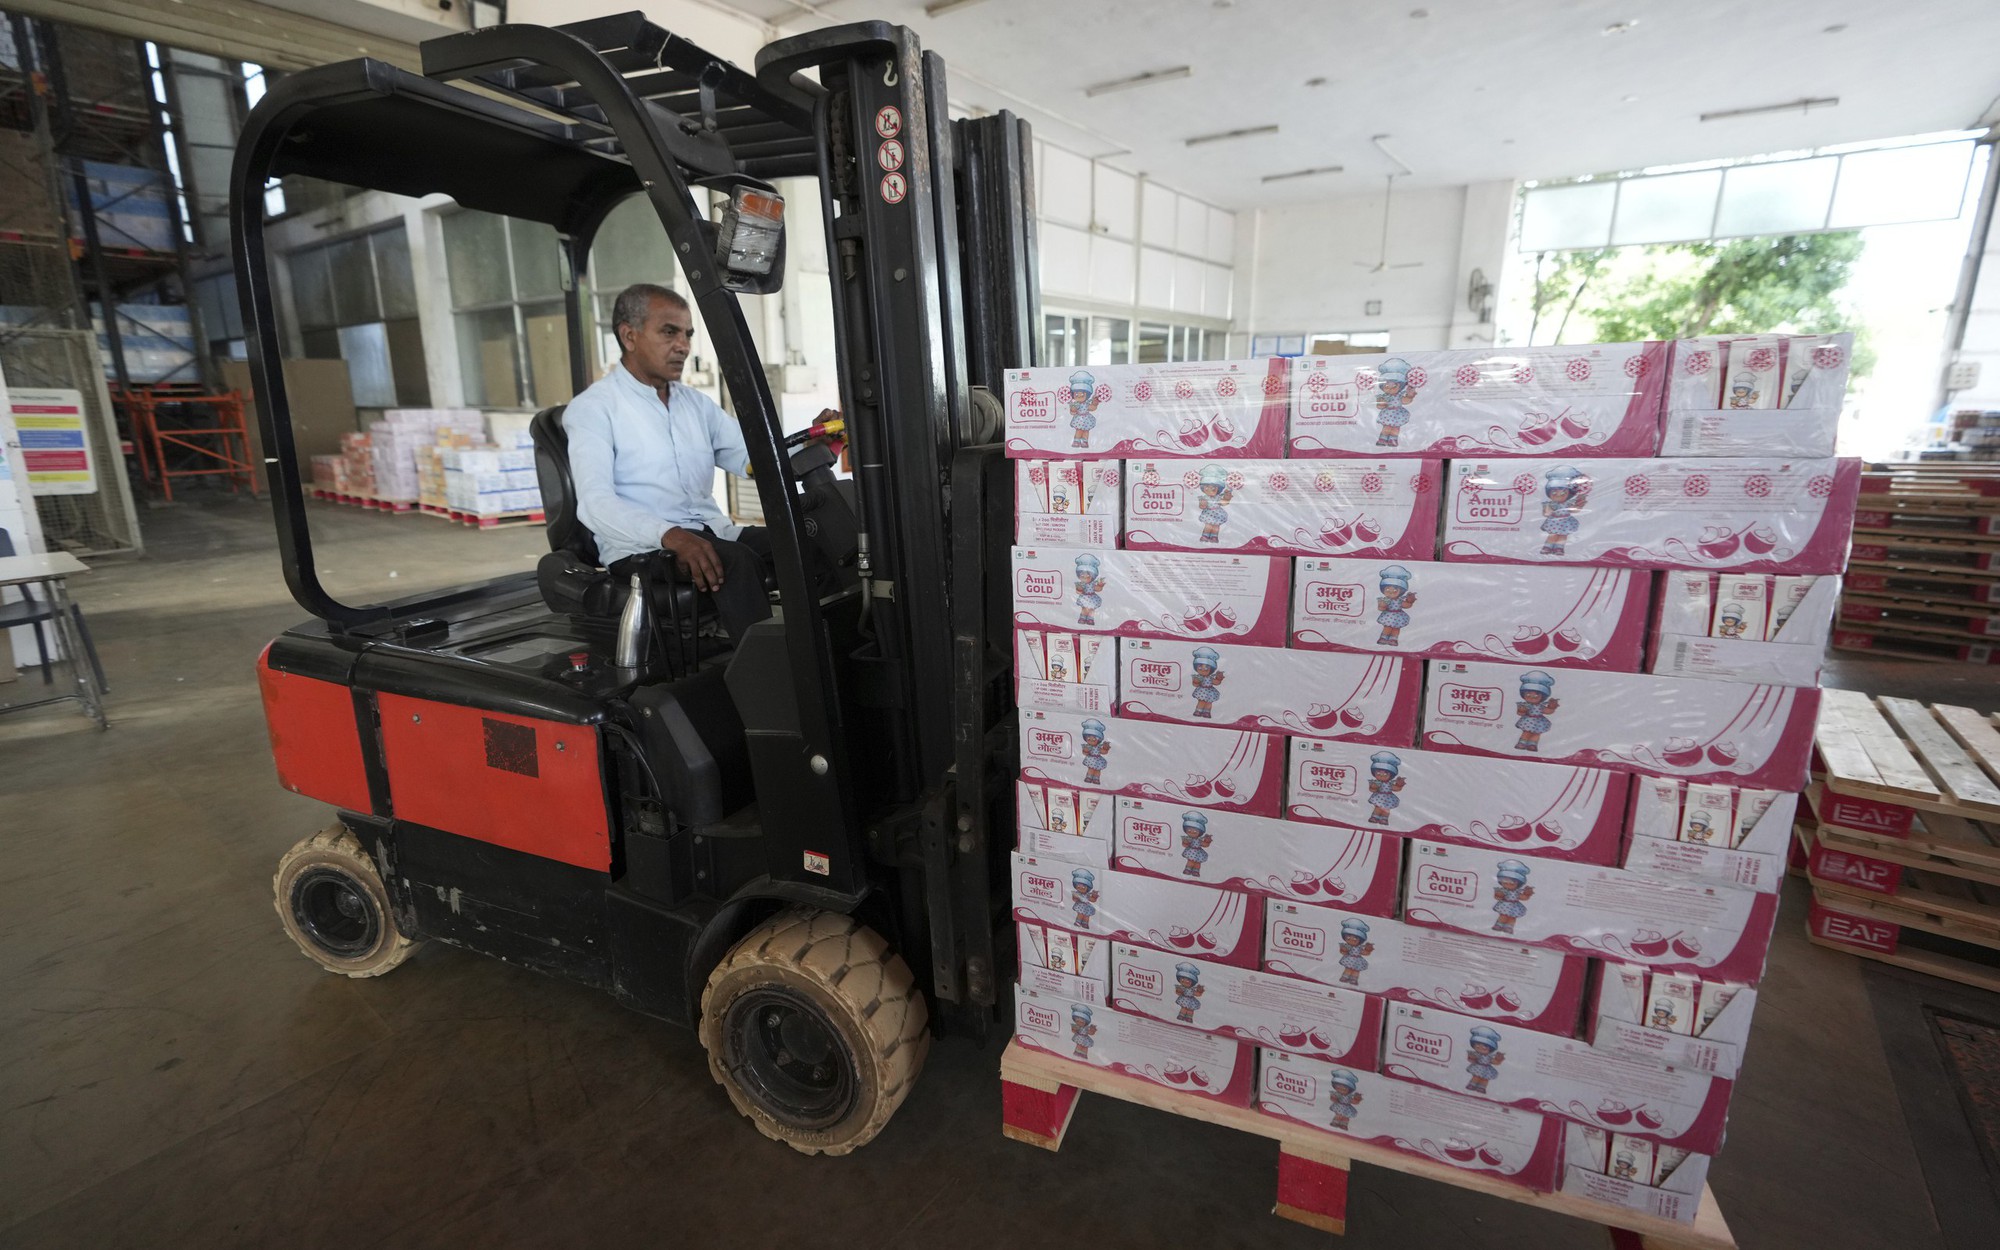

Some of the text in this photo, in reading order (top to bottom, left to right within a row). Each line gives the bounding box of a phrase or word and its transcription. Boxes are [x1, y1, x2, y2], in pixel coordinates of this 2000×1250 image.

[1310, 389, 1348, 400] Amul
[1018, 397, 1048, 407] Amul
[1311, 402, 1346, 412] GOLD
[1020, 409, 1047, 417] GOLD
[1141, 489, 1175, 500] Amul
[1468, 494, 1512, 506] Amul
[1143, 501, 1173, 510] GOLD
[1470, 508, 1508, 517] GOLD
[1024, 574, 1054, 584] Amul
[1026, 586, 1053, 594] GOLD
[1316, 587, 1354, 601] अमूल
[1140, 663, 1172, 677] अमूल
[1451, 688, 1492, 704] अमूल
[1036, 732, 1064, 745] अमूल
[1310, 766, 1347, 781] अमूल
[1133, 822, 1162, 836] अमूल
[1428, 871, 1467, 885] Amul
[1430, 883, 1464, 895] GOLD
[1282, 927, 1316, 941] Amul
[1283, 938, 1314, 949] GOLD
[1126, 969, 1156, 982] Amul
[1128, 978, 1154, 990] GOLD
[1027, 1008, 1054, 1021] Amul
[1029, 1016, 1052, 1028] GOLD
[1405, 1031, 1442, 1047] Amul
[1406, 1042, 1439, 1055] GOLD
[1275, 1072, 1307, 1088] Amul
[1276, 1082, 1305, 1095] GOLD
